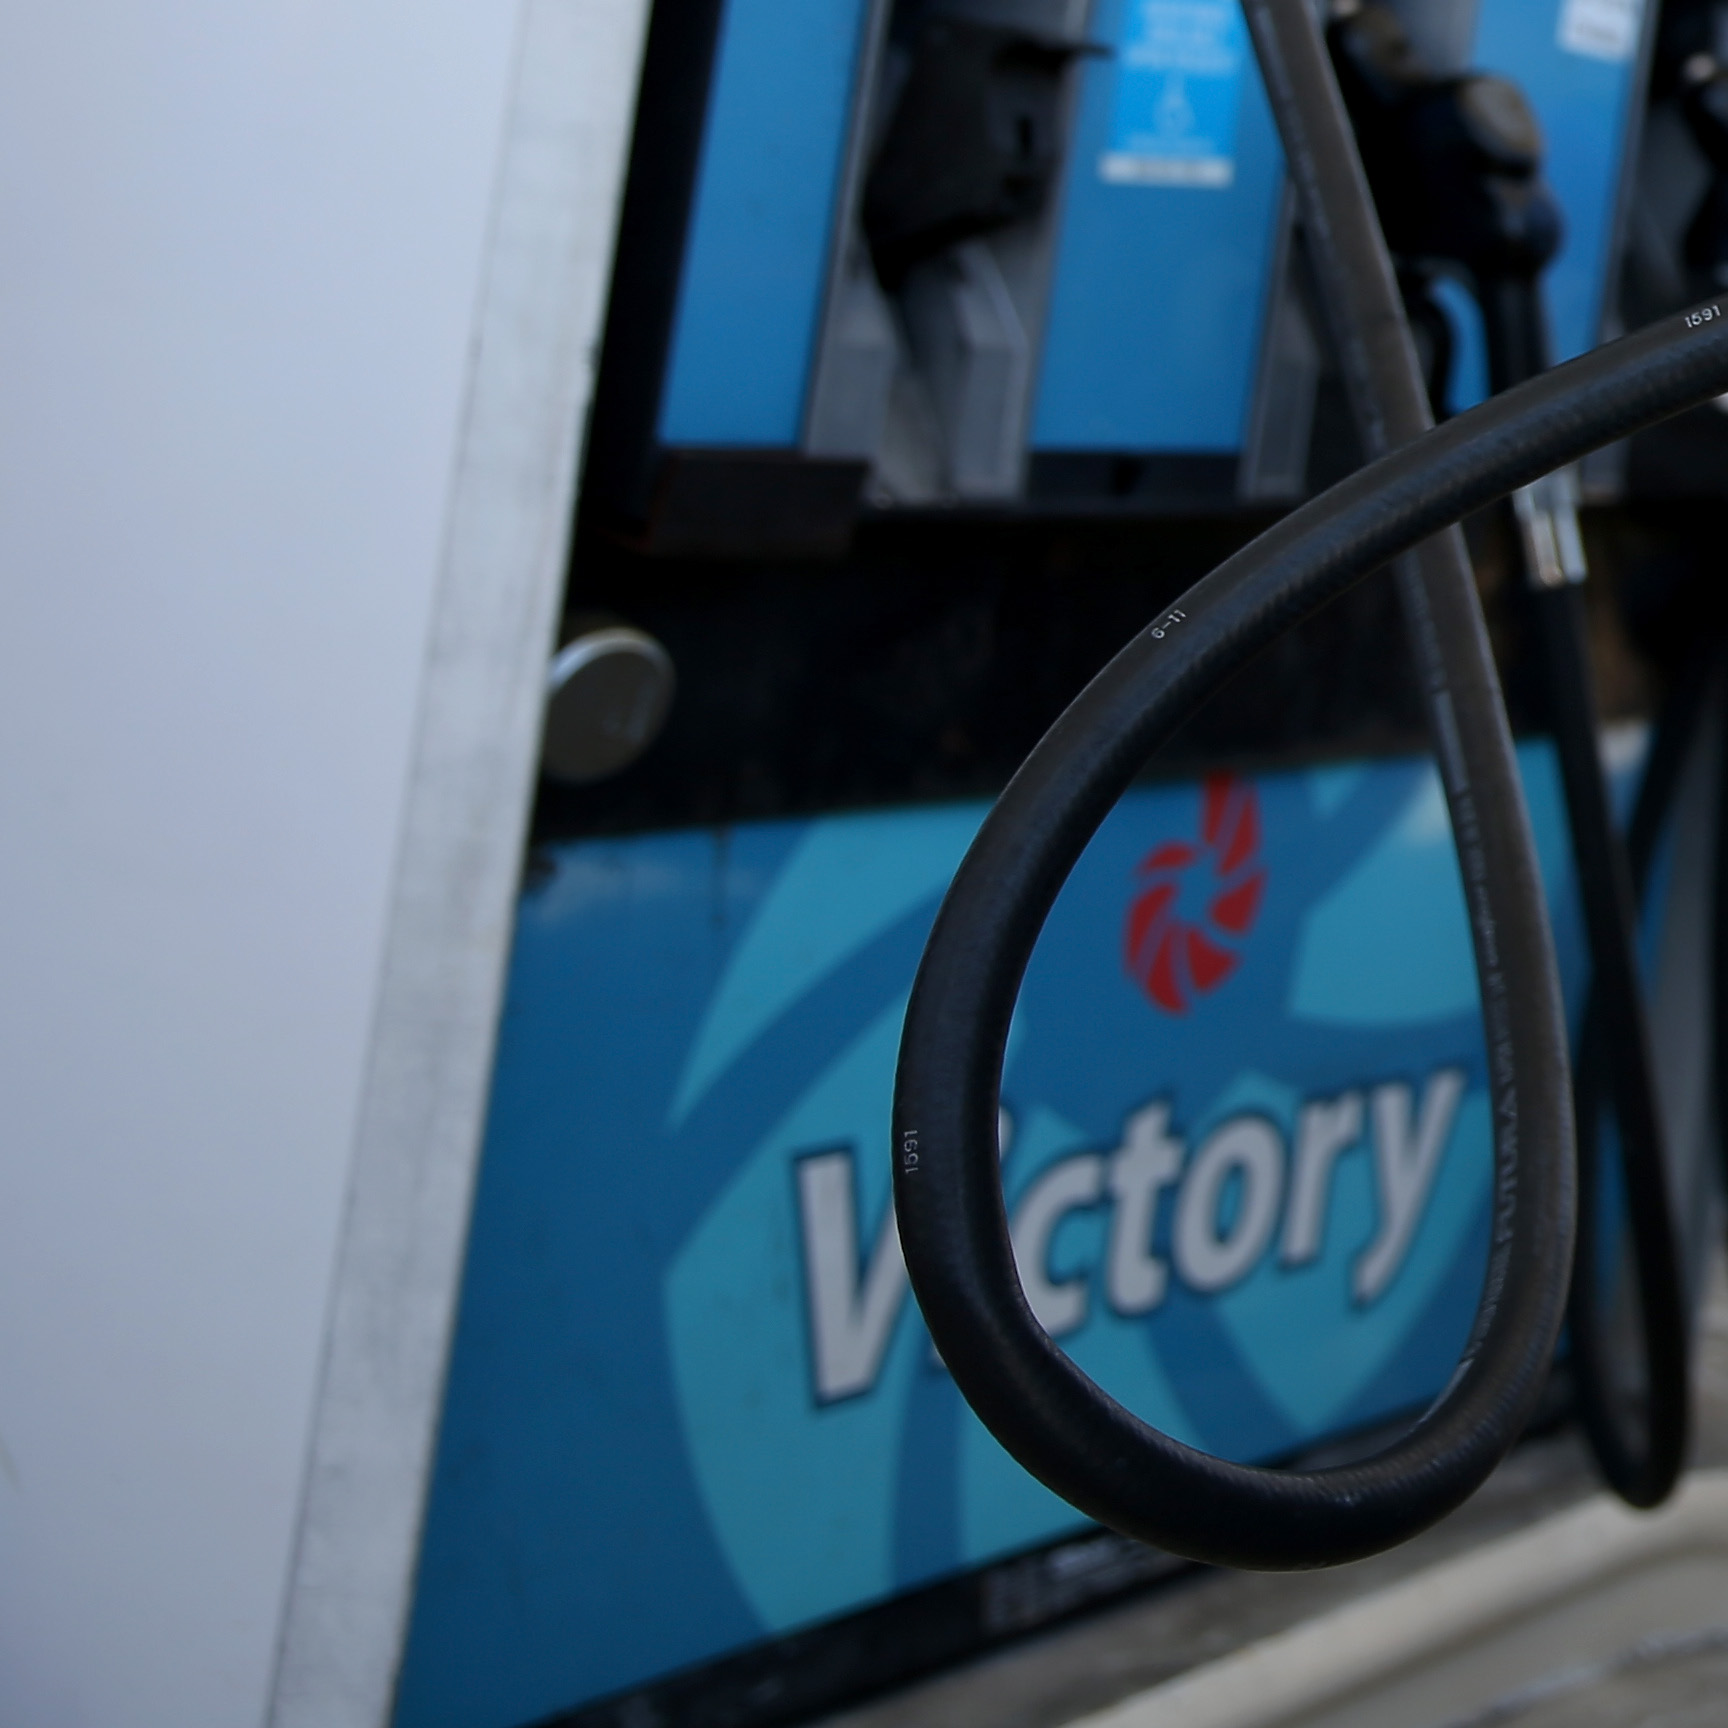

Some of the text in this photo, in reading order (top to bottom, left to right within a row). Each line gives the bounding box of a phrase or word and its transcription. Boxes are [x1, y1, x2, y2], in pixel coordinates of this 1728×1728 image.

[1684, 304, 1722, 328] 1591
[1150, 608, 1187, 639] 6-11
[799, 1068, 1467, 1406] Vctory
